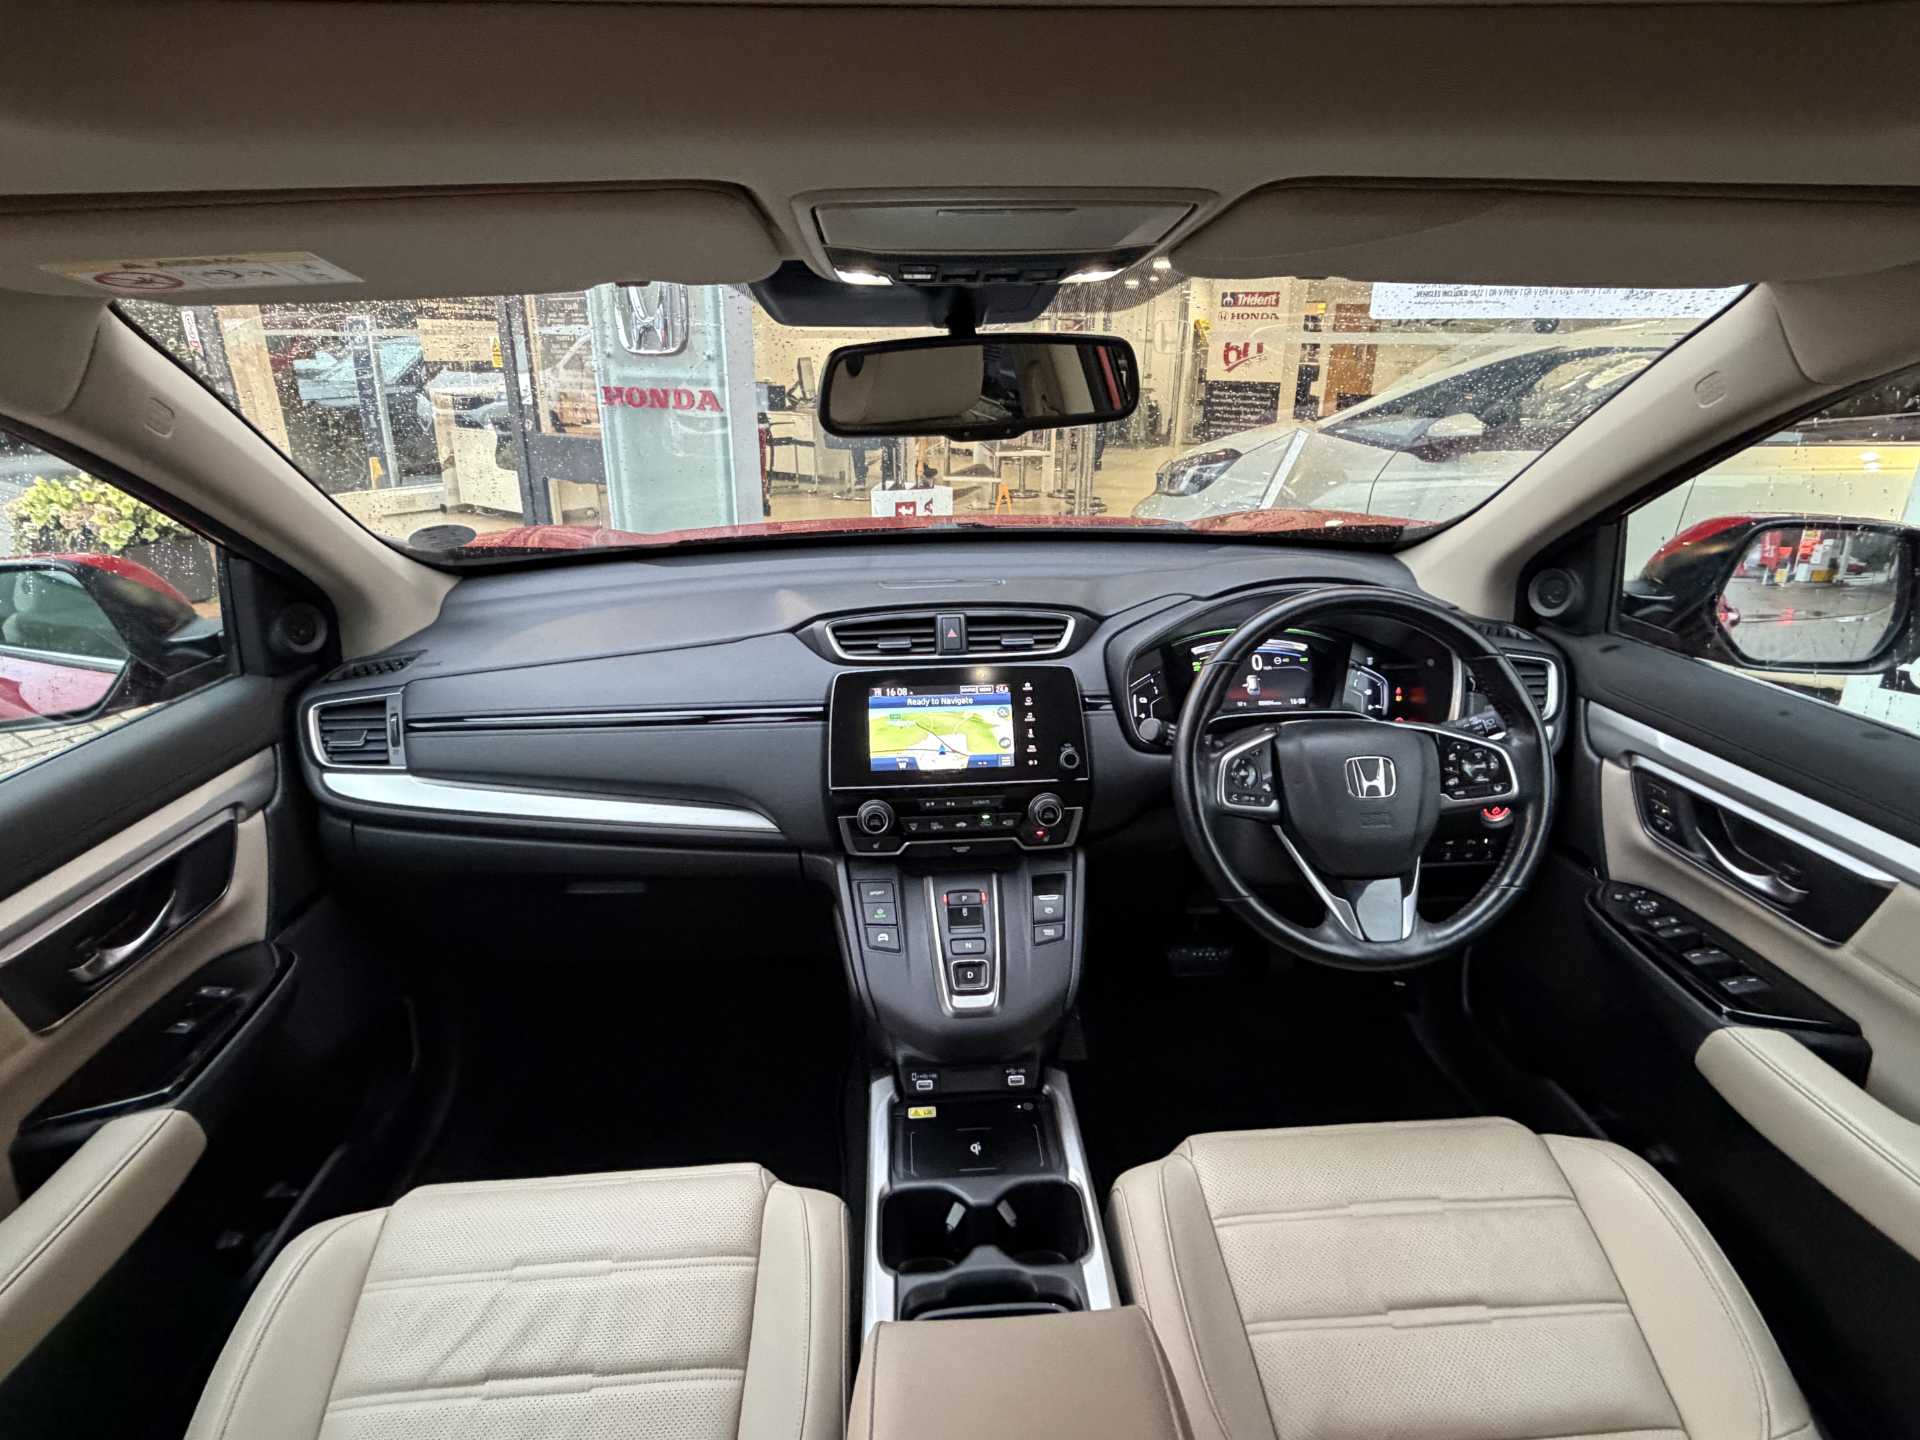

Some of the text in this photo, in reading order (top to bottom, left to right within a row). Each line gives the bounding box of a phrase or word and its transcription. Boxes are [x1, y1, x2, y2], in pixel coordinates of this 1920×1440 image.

[1237, 293, 1277, 306] Trident
[1231, 312, 1280, 320] HONDA
[601, 386, 724, 412] HONDA
[1251, 654, 1263, 671] 0
[906, 694, 974, 707] Ready to Navigate
[967, 971, 974, 979] D
